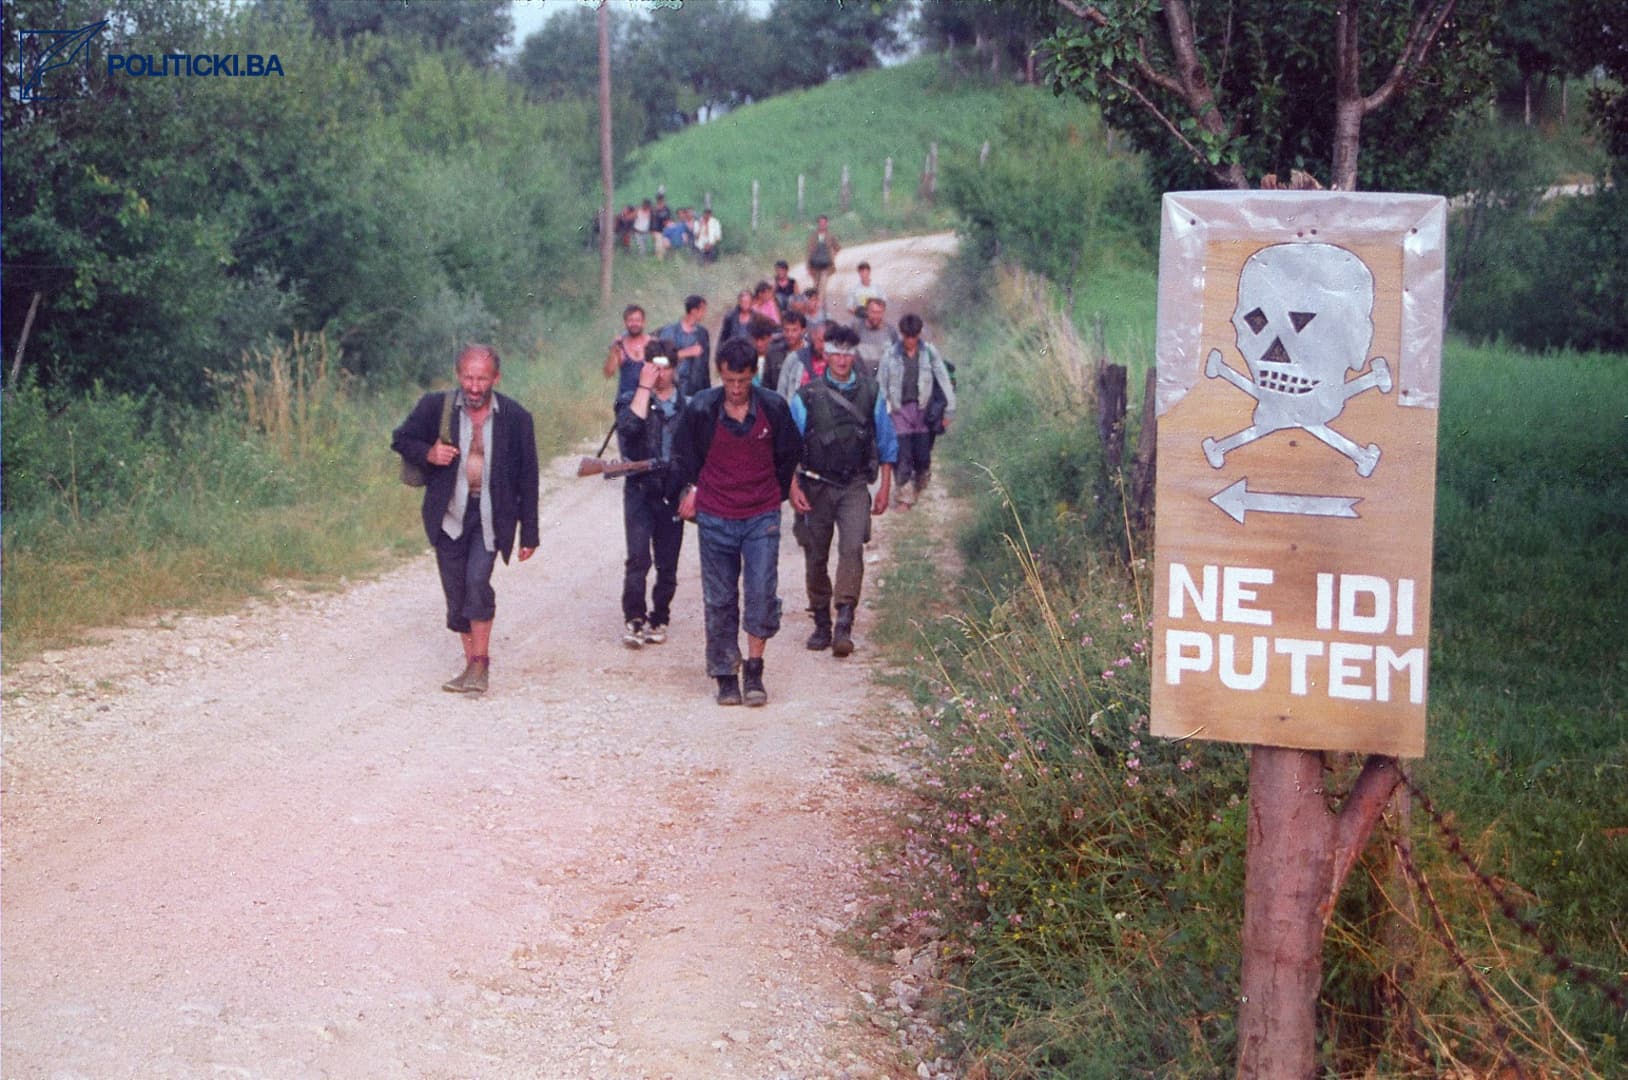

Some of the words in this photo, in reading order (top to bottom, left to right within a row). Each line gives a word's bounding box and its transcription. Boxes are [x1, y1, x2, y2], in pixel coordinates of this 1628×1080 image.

[1168, 563, 1274, 625] NE
[1316, 573, 1415, 636] IDI
[1165, 629, 1425, 704] PUTEM
